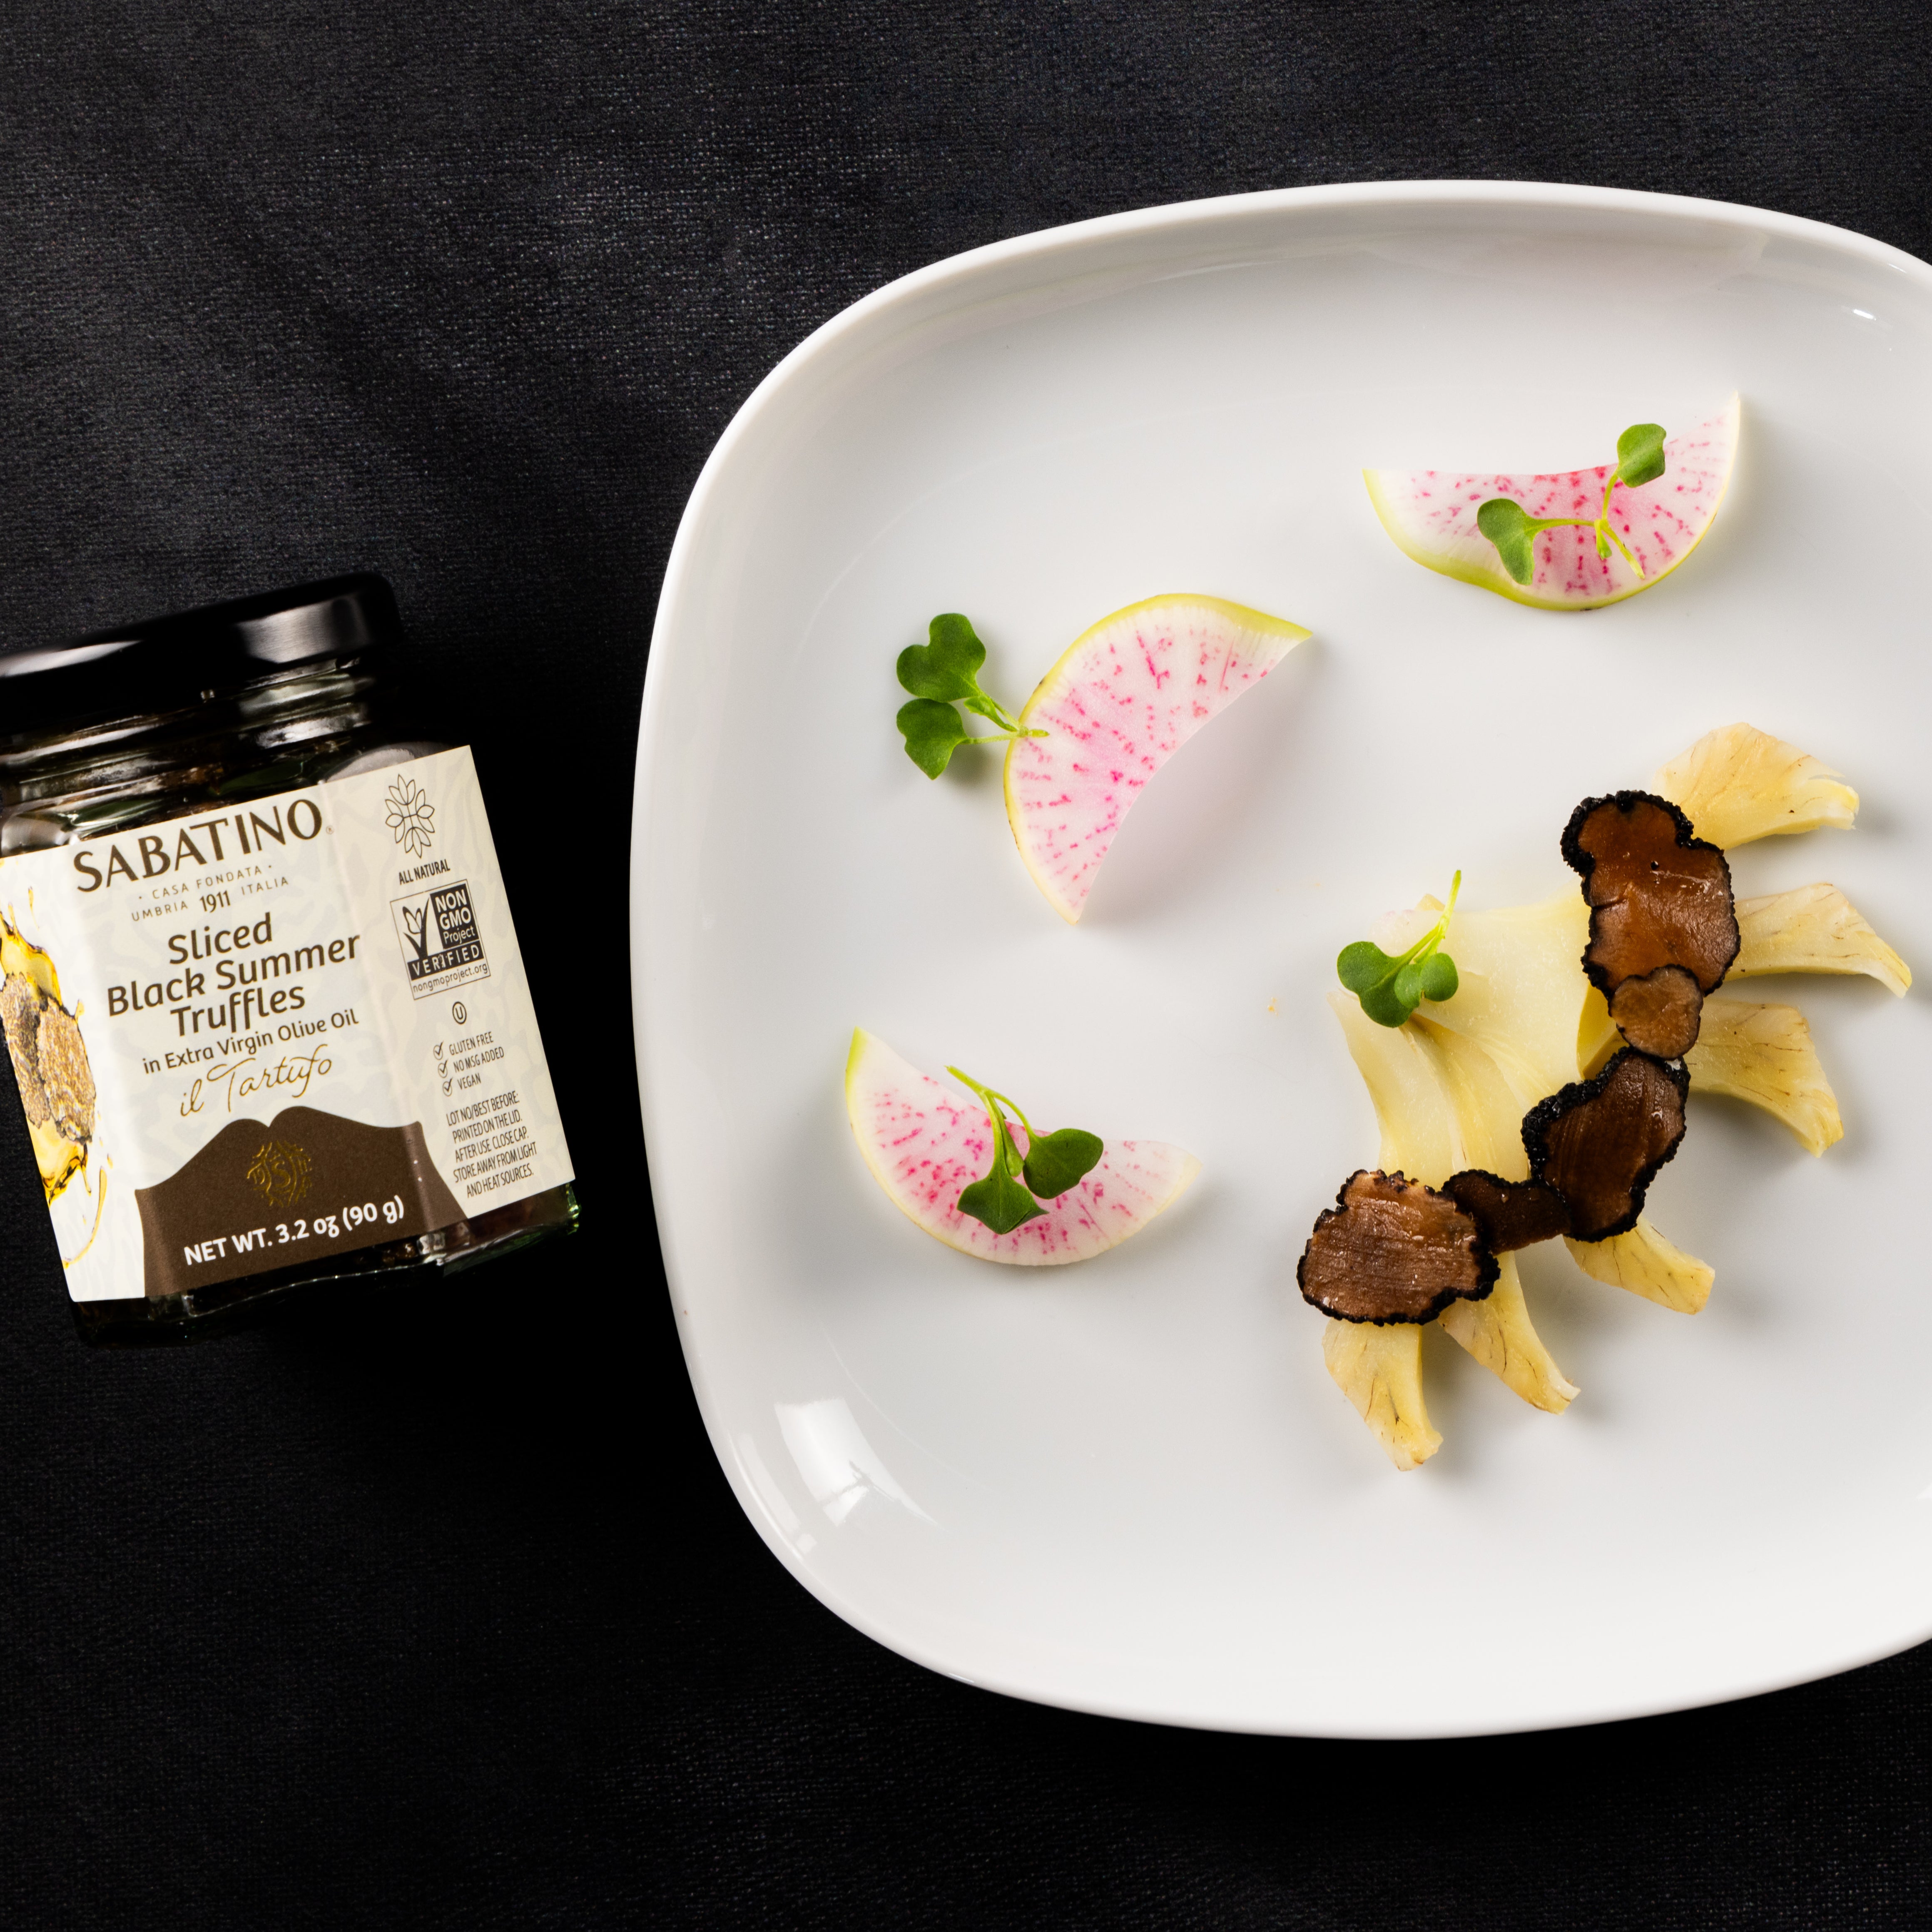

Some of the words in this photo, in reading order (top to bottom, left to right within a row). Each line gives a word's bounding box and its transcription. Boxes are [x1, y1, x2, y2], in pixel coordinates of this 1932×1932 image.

[74, 799, 322, 892] SABATINO
[152, 883, 189, 899] CASA
[196, 865, 261, 889] FONDATA
[398, 870, 414, 885] ALL
[413, 859, 451, 880] NATURAL
[131, 901, 188, 921] UMBRIA
[200, 890, 230, 913] 1911
[241, 876, 289, 895] ITALIA
[435, 889, 467, 913] NON
[440, 907, 471, 930] GMO
[443, 926, 475, 944] Project
[168, 912, 272, 964] Sliced
[107, 968, 205, 1016] Black
[216, 935, 360, 990] Summer
[412, 944, 479, 976] VERIFIED
[413, 963, 488, 993] nongmoproject.org
[170, 986, 305, 1036] Truffles
[142, 1058, 161, 1074] in
[164, 1047, 214, 1069] Extra
[217, 1033, 273, 1055] Virgin
[278, 1020, 327, 1041] Olive
[331, 1008, 359, 1028] Oil
[449, 1038, 476, 1056] GLUTEN
[476, 1031, 494, 1046] FREE
[453, 1059, 464, 1073] NO
[465, 1054, 481, 1069] MSG
[481, 1046, 504, 1064] ADDED
[180, 1078, 204, 1117] il
[207, 1043, 332, 1112] Tartufo
[457, 1073, 481, 1090] VEGAN
[446, 1110, 460, 1126] LOT
[460, 1100, 490, 1121] NO/BEST
[490, 1090, 520, 1111] BEFORE:
[452, 1123, 483, 1143] PRINTED
[483, 1118, 495, 1133] ON
[494, 1113, 509, 1129] THE
[509, 1109, 523, 1125] LID.
[453, 1163, 477, 1183] STORE
[477, 1156, 496, 1175] AWAY
[497, 1149, 518, 1167] FROM
[517, 1141, 537, 1160] LIGHT
[455, 1144, 478, 1163] AFTER
[477, 1139, 492, 1155] USE
[492, 1131, 515, 1150] CLOSE
[514, 1126, 529, 1143] CAP.
[467, 1182, 482, 1198] AND
[482, 1174, 500, 1192] HEAT
[502, 1163, 534, 1185] SOURCES.
[184, 1237, 227, 1265] NET
[231, 1228, 273, 1253] WT.
[275, 1219, 309, 1243] 3.2
[314, 1215, 340, 1238] oz
[343, 1203, 378, 1231] (90
[383, 1195, 404, 1224] g)
